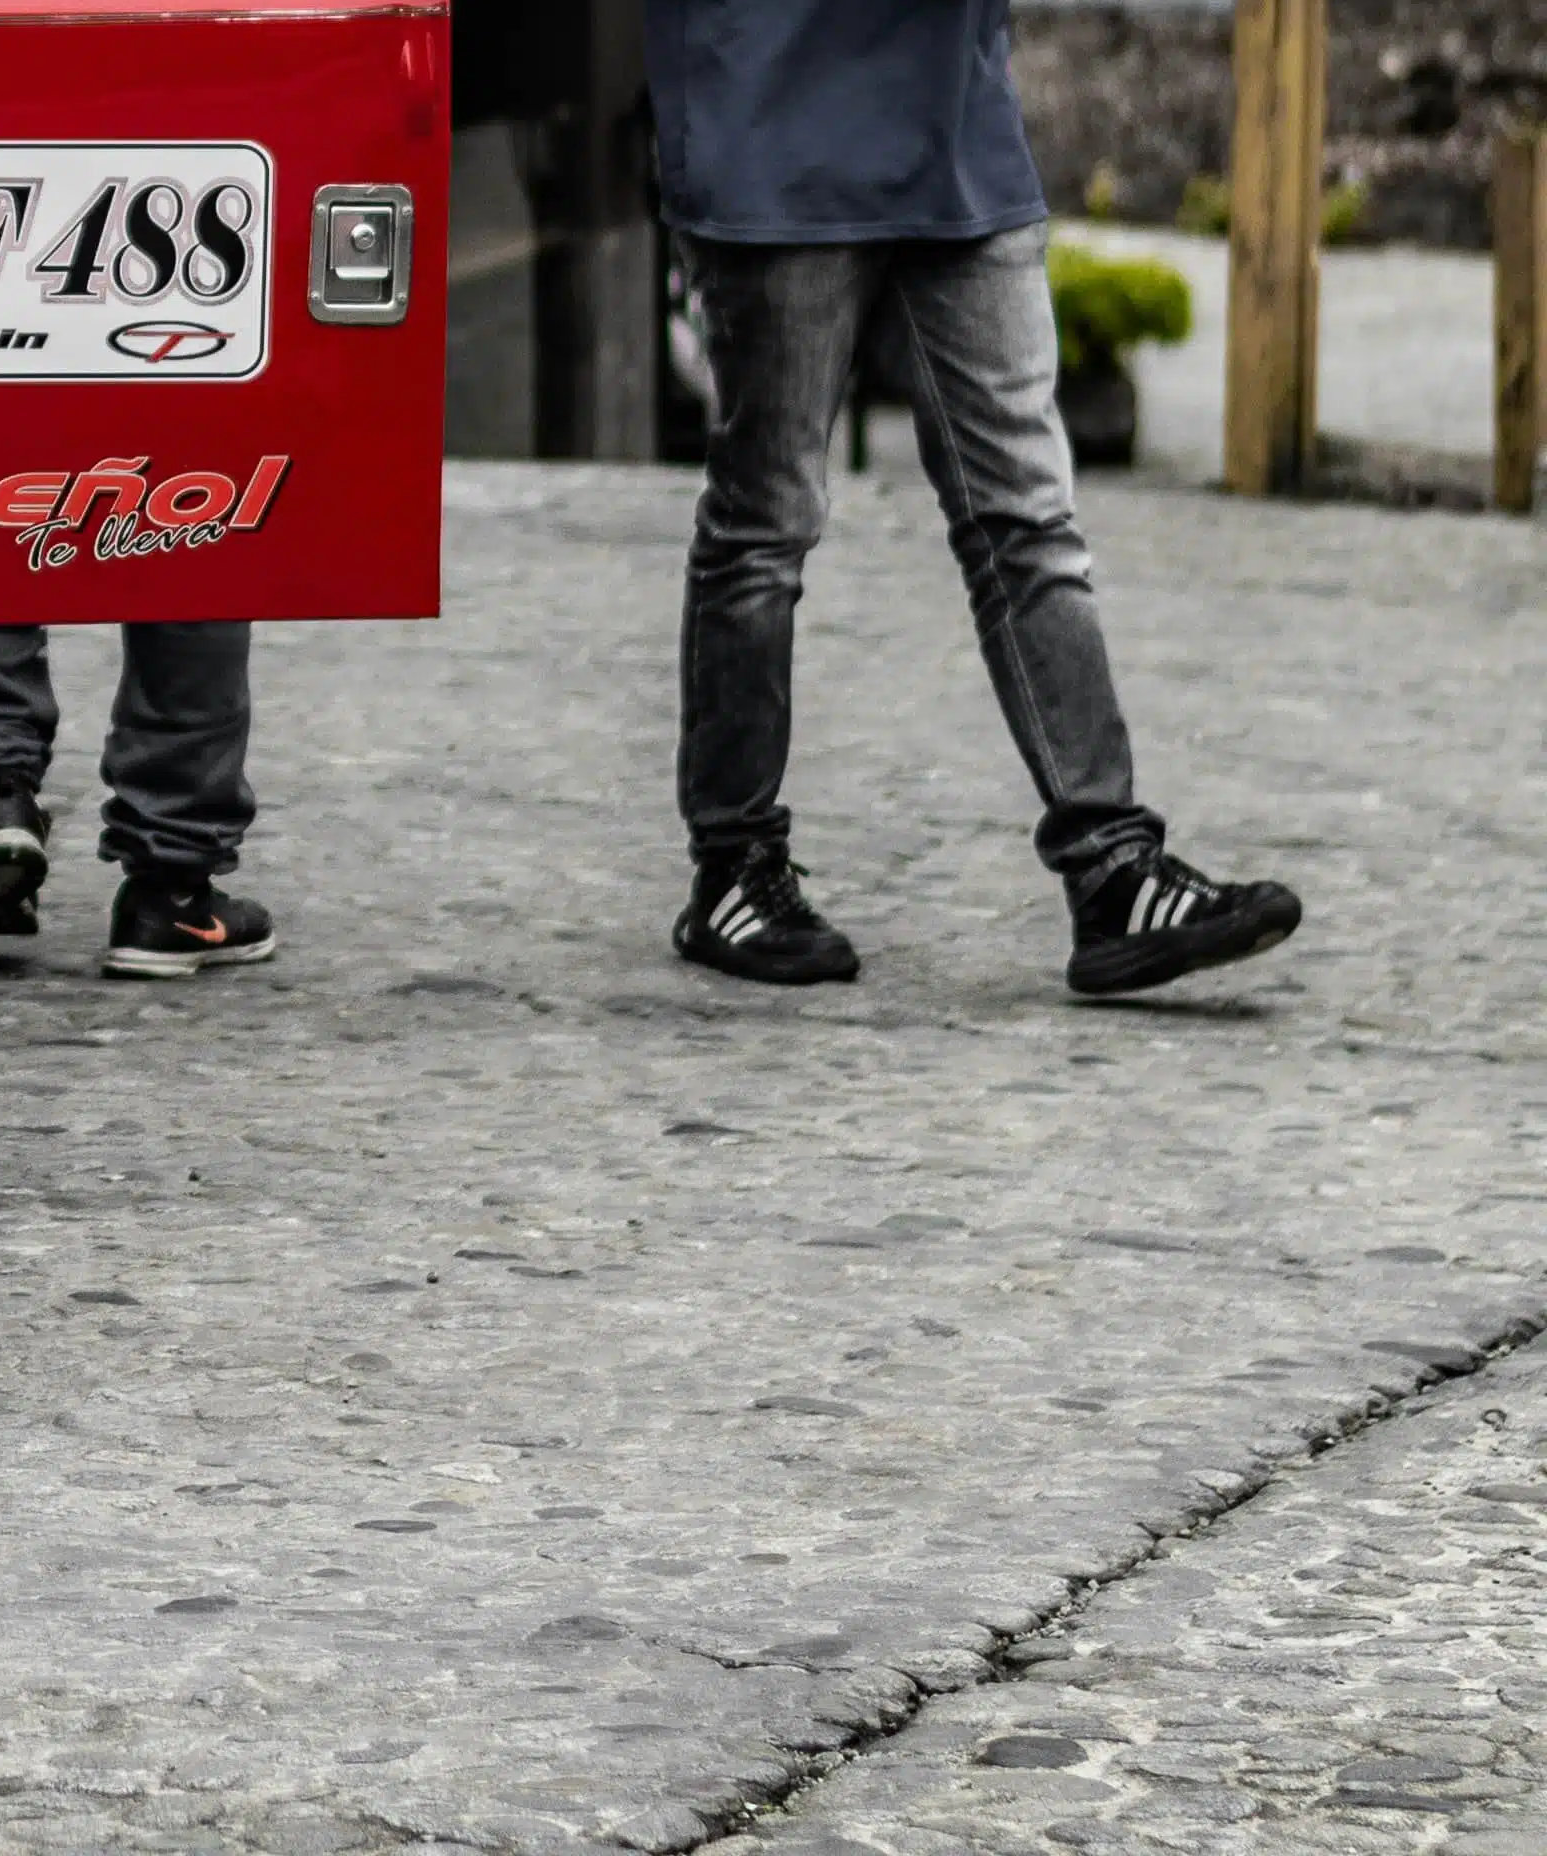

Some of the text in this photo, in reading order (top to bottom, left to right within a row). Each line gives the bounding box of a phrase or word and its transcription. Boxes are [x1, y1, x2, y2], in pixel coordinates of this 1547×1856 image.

[32, 175, 256, 305] 488
[18, 513, 225, 572] Te lleva
